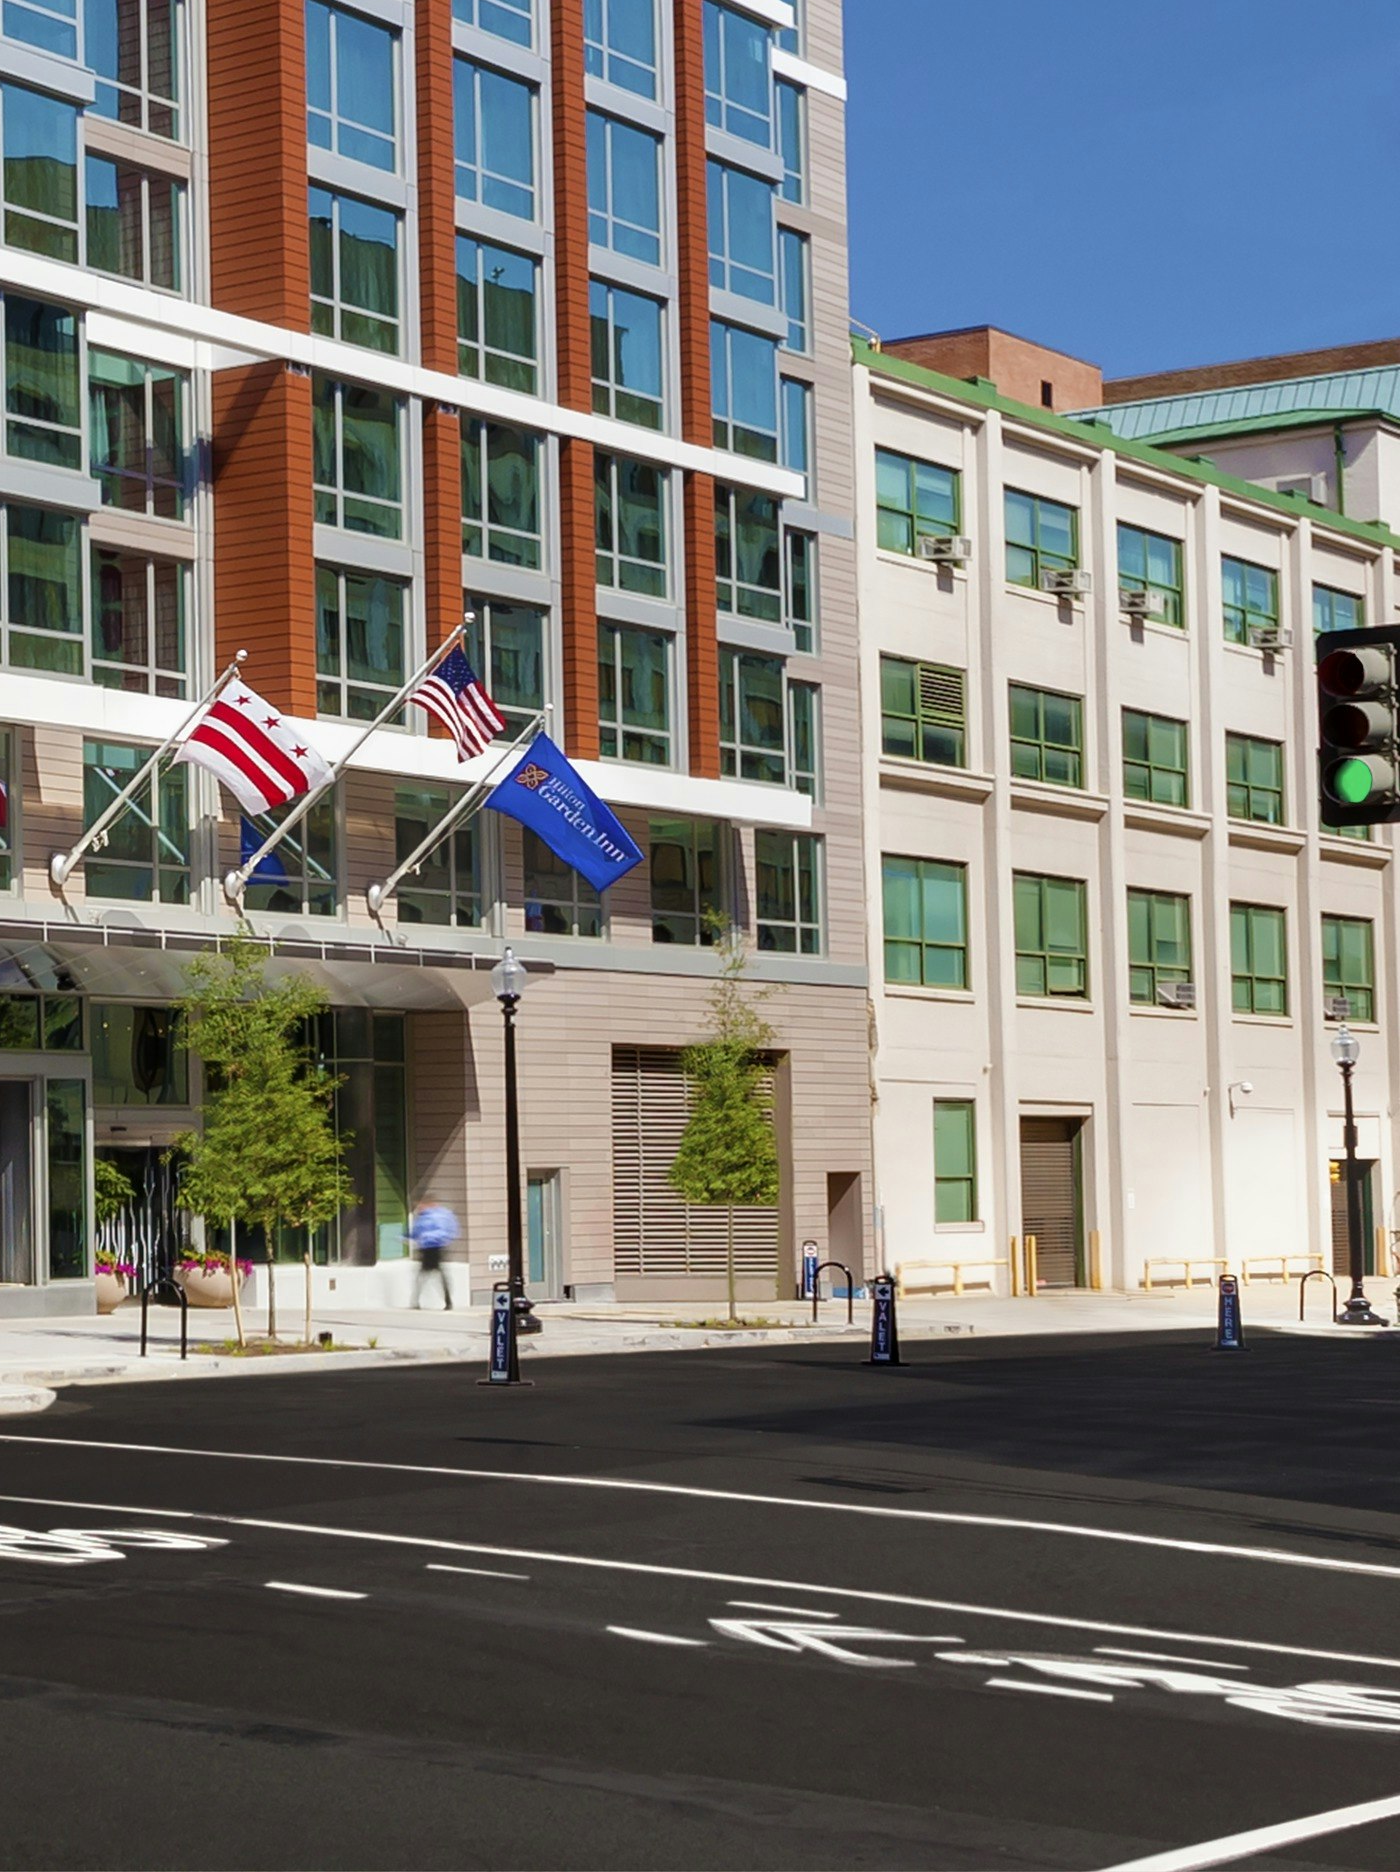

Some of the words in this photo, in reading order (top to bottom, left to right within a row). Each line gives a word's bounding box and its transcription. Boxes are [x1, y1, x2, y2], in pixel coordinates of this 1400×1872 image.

[547, 776, 586, 810] Hilton
[538, 785, 597, 839] Garden
[593, 832, 626, 863] Inn
[496, 1312, 506, 1369] VALET
[878, 1302, 887, 1351] VALET
[1224, 1296, 1233, 1339] HERE
